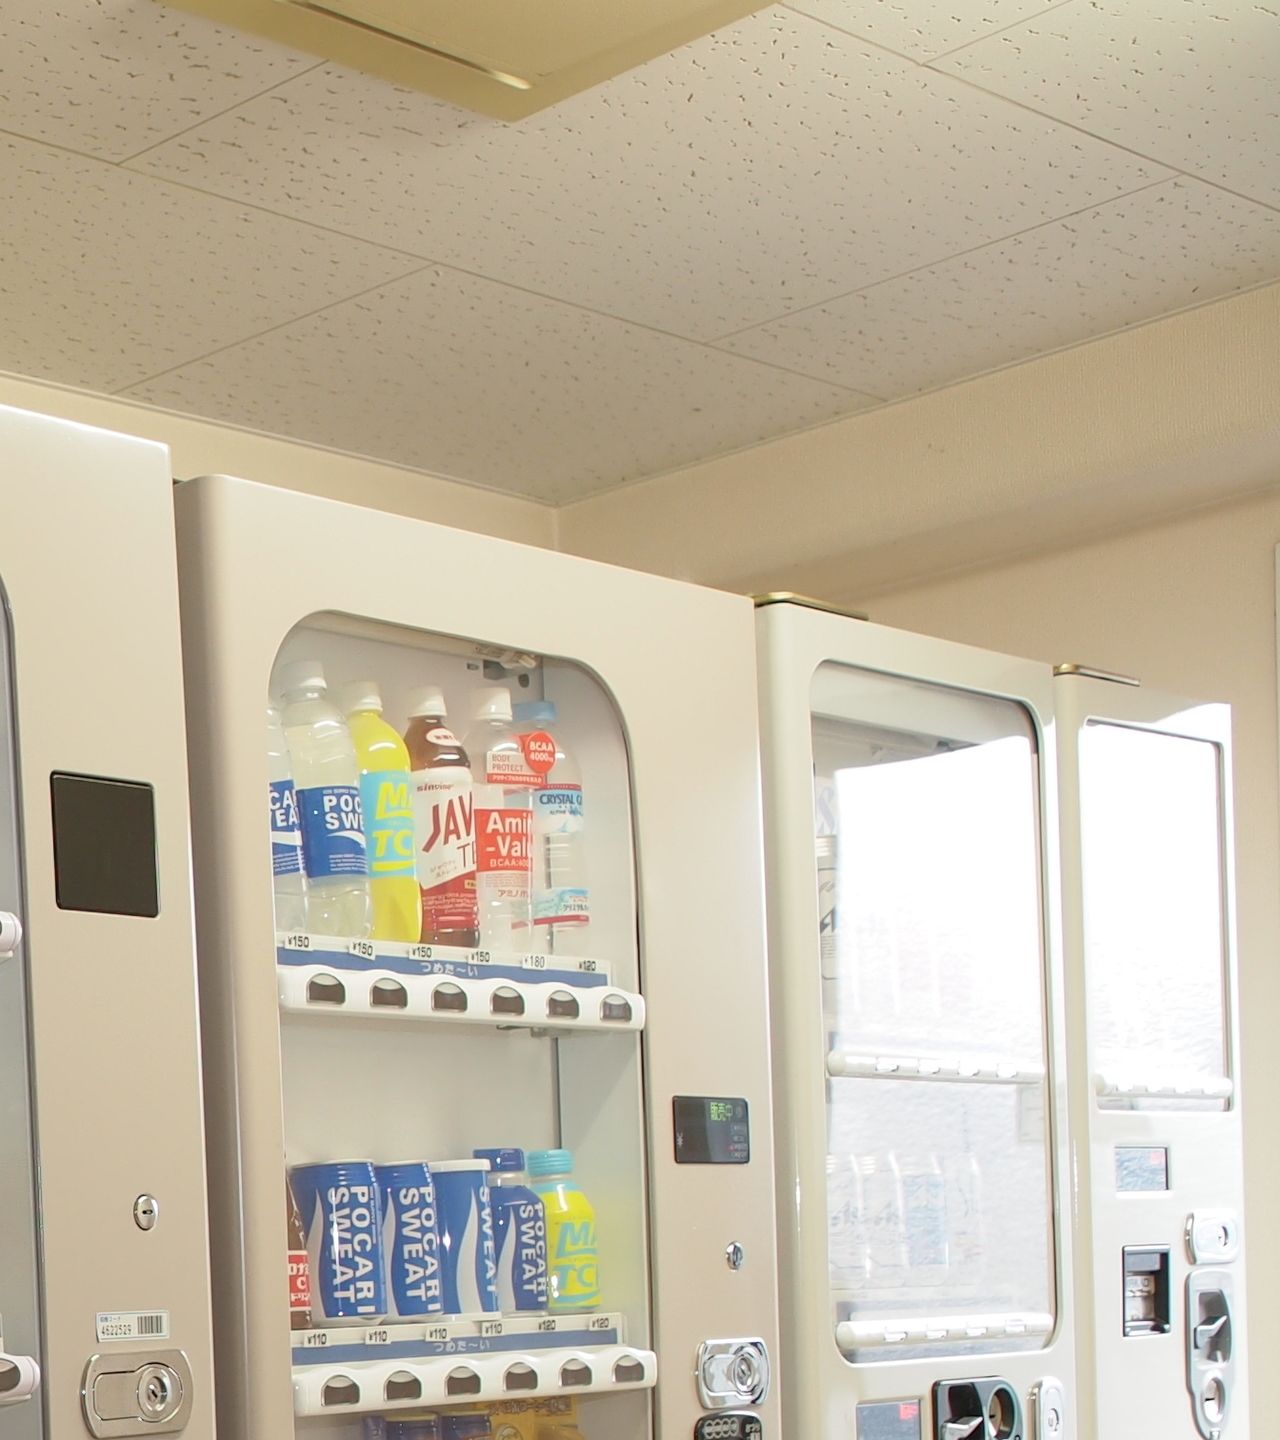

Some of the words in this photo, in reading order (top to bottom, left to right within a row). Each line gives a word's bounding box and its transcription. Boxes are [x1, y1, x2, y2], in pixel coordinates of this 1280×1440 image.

[529, 742, 554, 752] BCAA
[492, 754, 510, 762] BODY
[492, 764, 523, 772] PROTECT
[540, 794, 575, 806] CRYSTAL
[288, 936, 310, 948] ¥150
[353, 942, 373, 957] ¥150
[411, 947, 432, 959] ¥150
[524, 956, 545, 968] ¥180
[327, 1186, 355, 1303] SWEAT
[350, 1186, 376, 1313] POCARI
[399, 1187, 425, 1303] SWEAT
[520, 1204, 538, 1293] SWEAT
[429, 1328, 448, 1339] ¥110
[485, 1323, 503, 1335] ¥110
[307, 1333, 327, 1345] ¥110
[369, 1331, 388, 1342] ¥110
